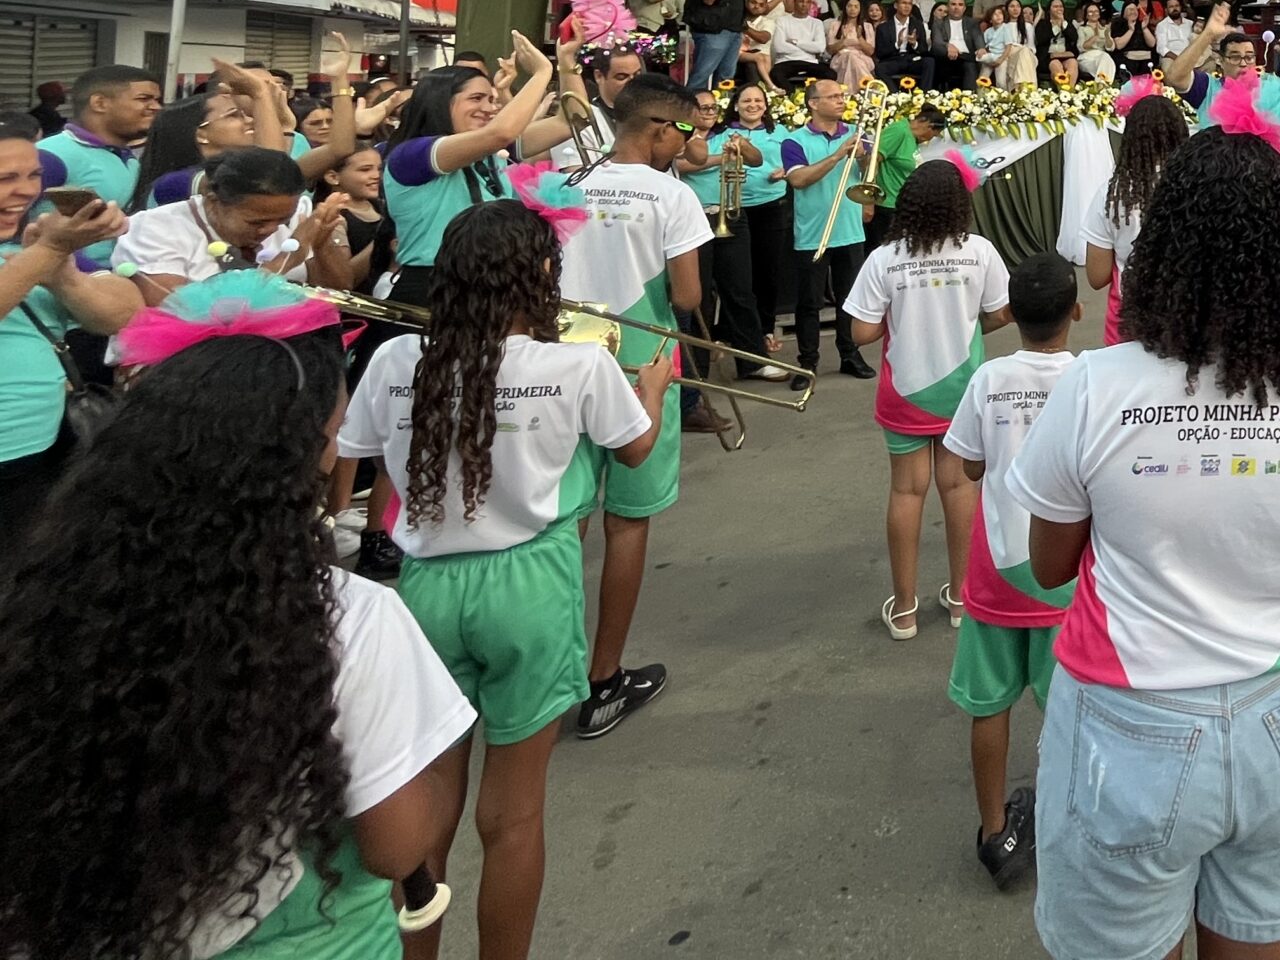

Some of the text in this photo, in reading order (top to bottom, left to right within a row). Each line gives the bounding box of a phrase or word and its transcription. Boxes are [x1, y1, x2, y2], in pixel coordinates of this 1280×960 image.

[584, 189, 660, 203] MINHA PRIMEIRA
[886, 258, 979, 274] PROJETO MINHA PRIMEIRA
[495, 385, 562, 398] PRIMEIRA
[986, 391, 1049, 403] PROJETO MINH
[1120, 405, 1199, 426] PROJETO
[1203, 404, 1265, 422] MINHA
[1177, 425, 1220, 444] OPÇÃO
